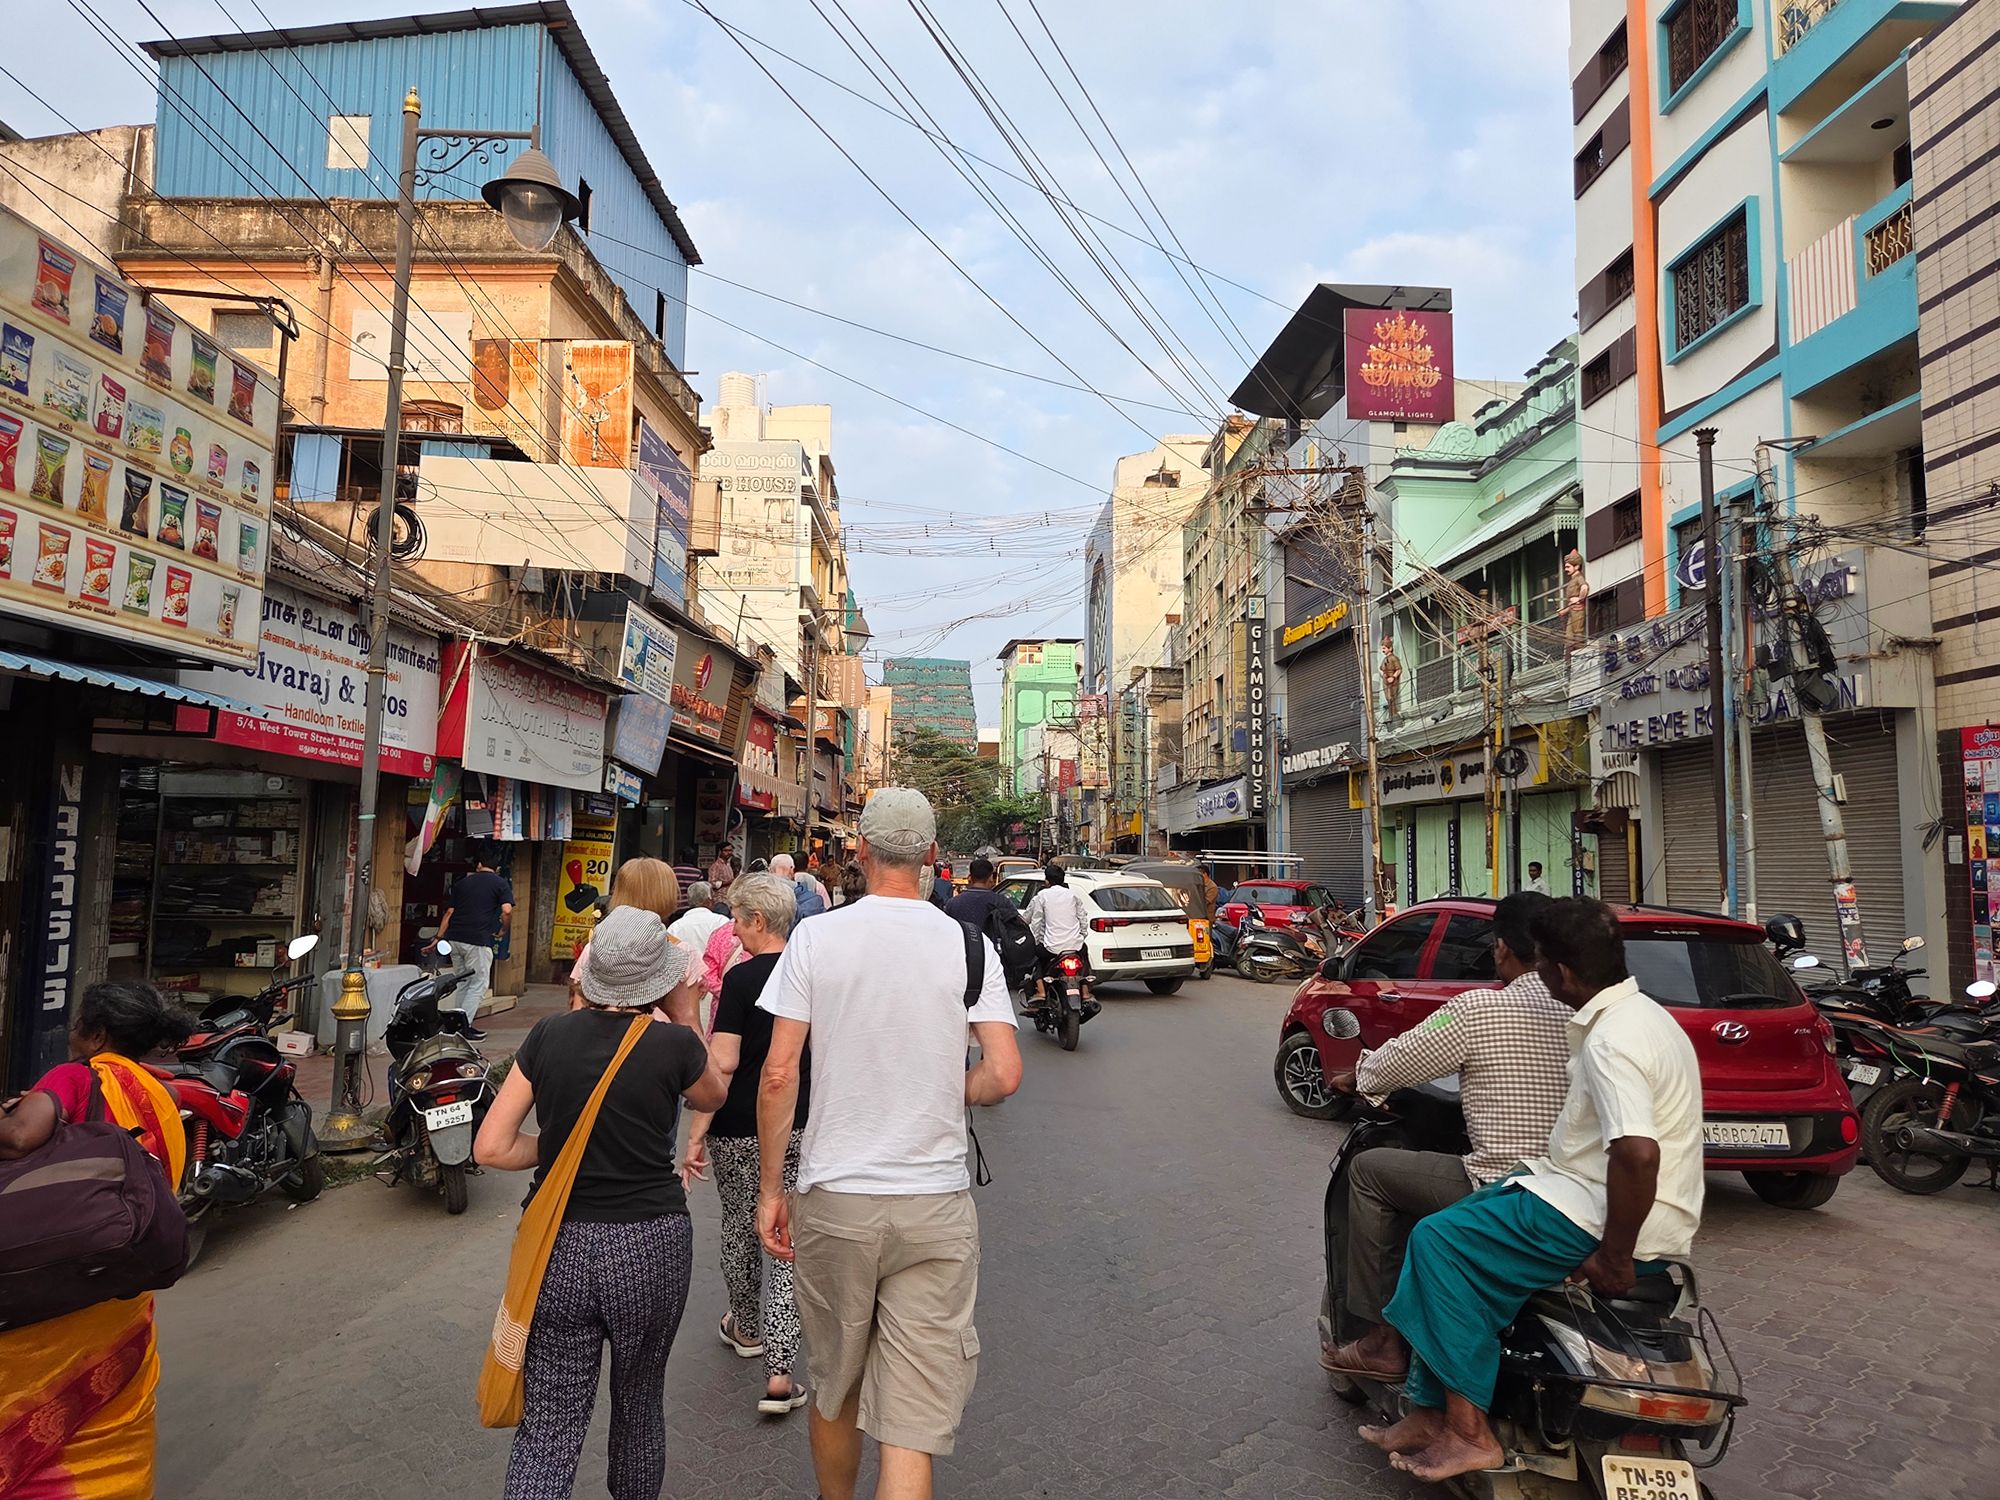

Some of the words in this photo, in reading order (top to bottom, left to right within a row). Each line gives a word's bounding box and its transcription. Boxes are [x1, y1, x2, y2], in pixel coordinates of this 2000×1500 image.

[736, 476, 796, 492] HOUSE
[225, 651, 331, 705] lvaraj
[338, 675, 355, 704] &
[284, 702, 335, 727] Handloom
[259, 721, 281, 735] West
[283, 727, 309, 741] Tower
[1606, 720, 1642, 750] THE
[1648, 710, 1687, 742] EYE
[586, 859, 609, 876] 20
[435, 1108, 448, 1117] TN
[450, 1104, 461, 1113] 64
[436, 1120, 442, 1128] P
[444, 1114, 466, 1126] 5257
[1702, 1127, 1783, 1144] N58BC2477
[1621, 1467, 1676, 1488] TN-59
